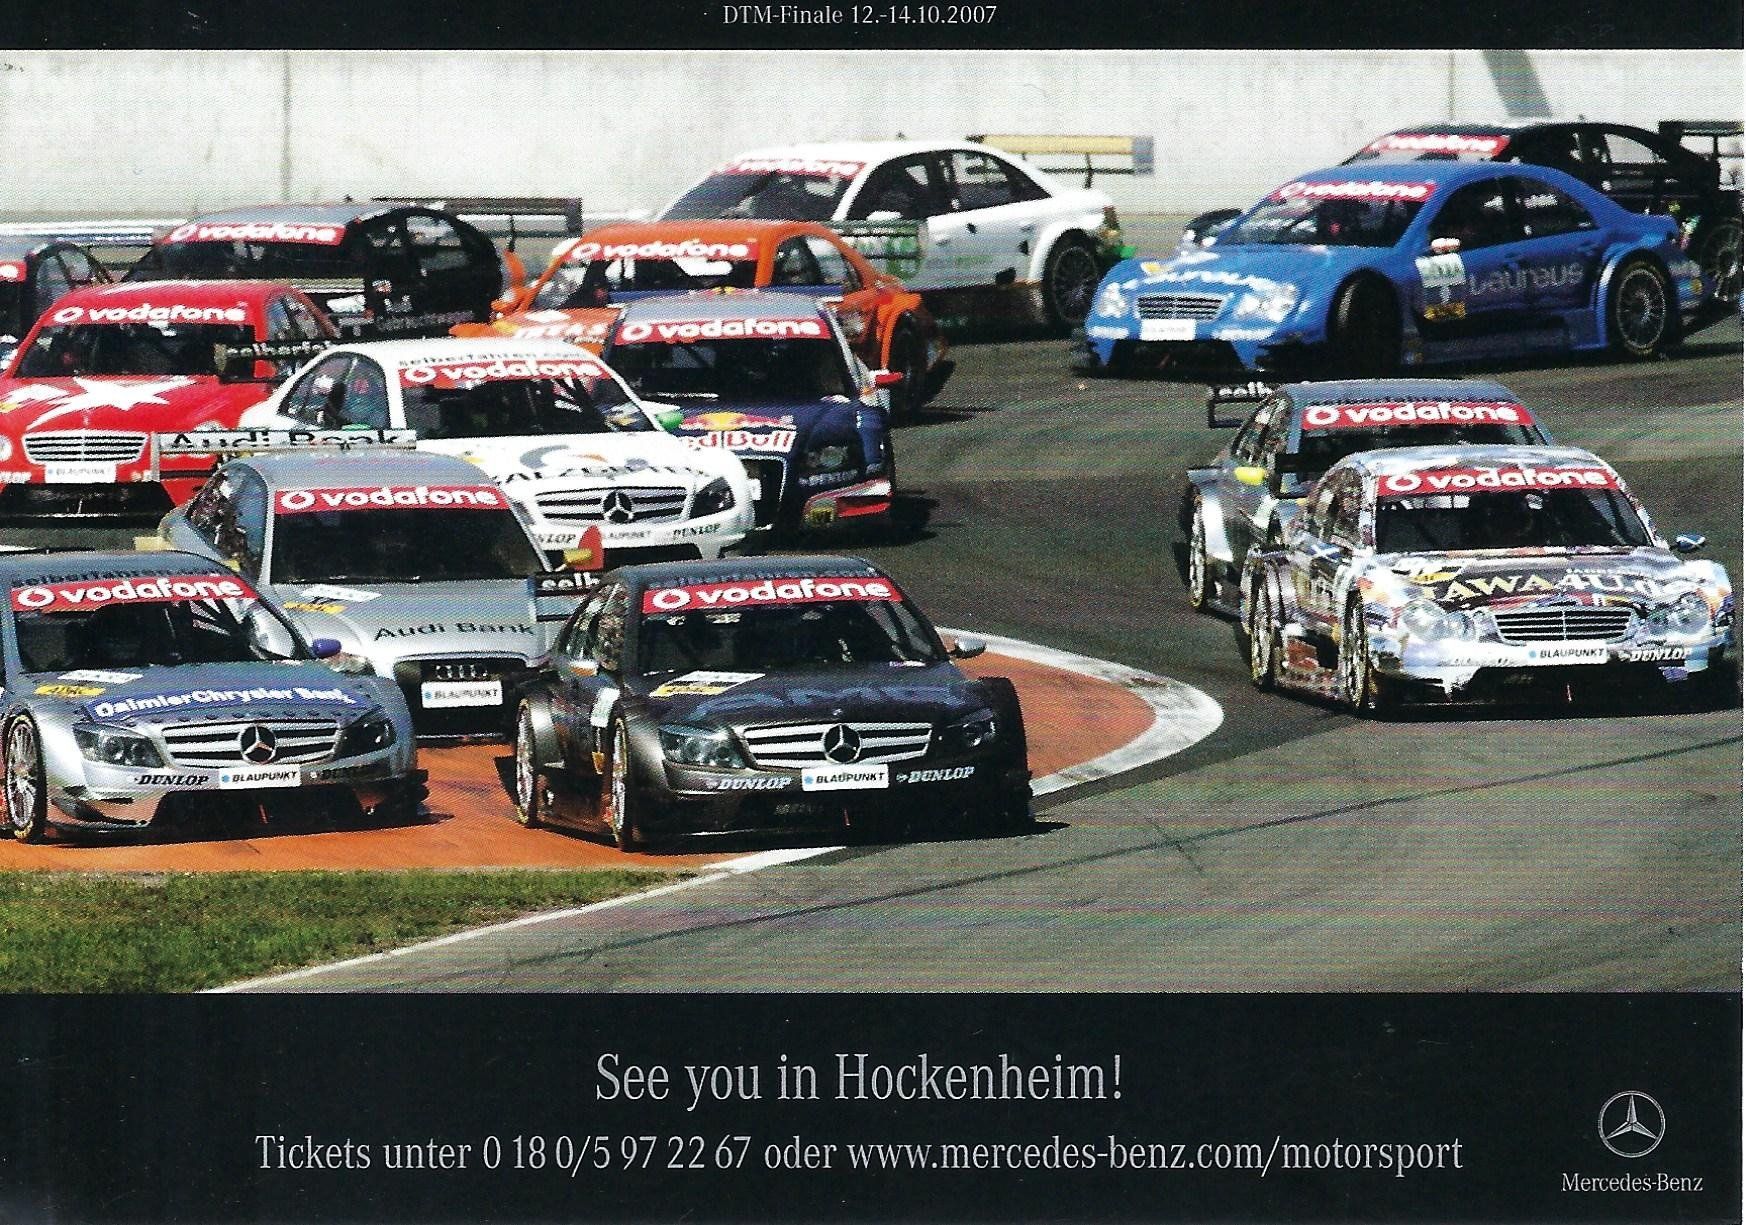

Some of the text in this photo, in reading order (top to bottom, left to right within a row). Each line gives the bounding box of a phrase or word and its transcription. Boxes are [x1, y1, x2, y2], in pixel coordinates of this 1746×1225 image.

[603, 239, 748, 258] vodafone
[89, 302, 246, 322] vodafone
[658, 317, 821, 339] vodafone
[440, 358, 603, 379] vodafone
[1344, 402, 1521, 424] vodafone
[173, 430, 270, 448] Audi
[1427, 468, 1609, 489] vodafone
[323, 486, 498, 508] vodafone
[60, 578, 244, 603] vodafone
[696, 579, 892, 604] vodafone
[373, 620, 536, 642] Audi Bank
[1539, 648, 1605, 660] BLAUPUNKT
[1631, 647, 1692, 663] DUNLOP
[433, 687, 500, 701] BLAUPUNKT
[138, 773, 209, 787] DUNLOP
[231, 771, 301, 784] BLAUPUNKT
[717, 776, 793, 790] DUNLOP
[815, 771, 886, 785] BLAUPUNKT
[907, 765, 976, 783] DUNLOP
